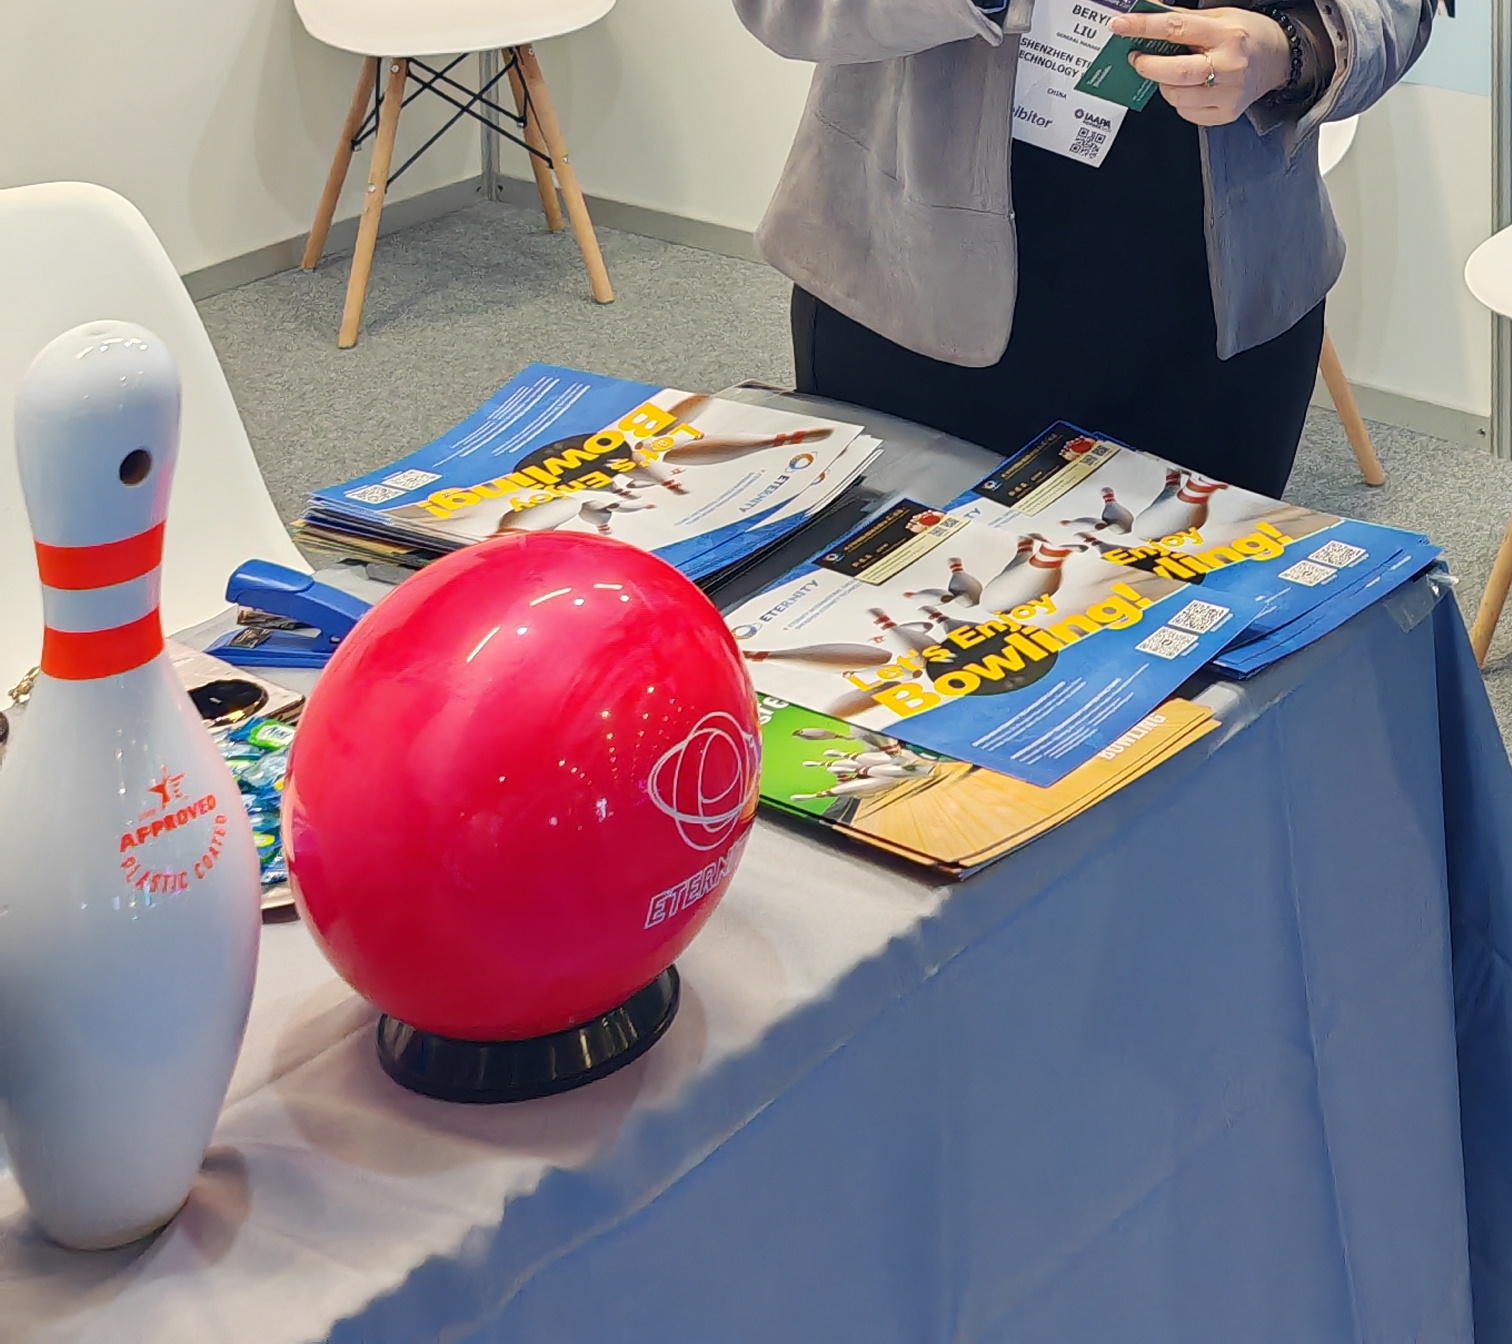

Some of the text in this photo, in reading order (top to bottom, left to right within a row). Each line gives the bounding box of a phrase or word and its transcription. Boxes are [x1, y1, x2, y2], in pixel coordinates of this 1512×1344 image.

[1056, 32, 1101, 51] GENERAL MANAGE
[1074, 23, 1097, 38] LIU
[1020, 38, 1074, 63] SHENZHEN
[1019, 52, 1079, 78] ECHNOLOGY
[1047, 88, 1067, 99] CHINA
[1014, 106, 1053, 128] ibitor
[1084, 112, 1111, 128] IAAPA
[1102, 527, 1204, 566] Enjoy
[1153, 521, 1294, 580] ling!
[759, 579, 819, 622] ETERNITY
[843, 593, 1057, 692] Let's Enjoy
[872, 582, 1154, 718] Bowling!
[120, 794, 217, 853] APPROVED
